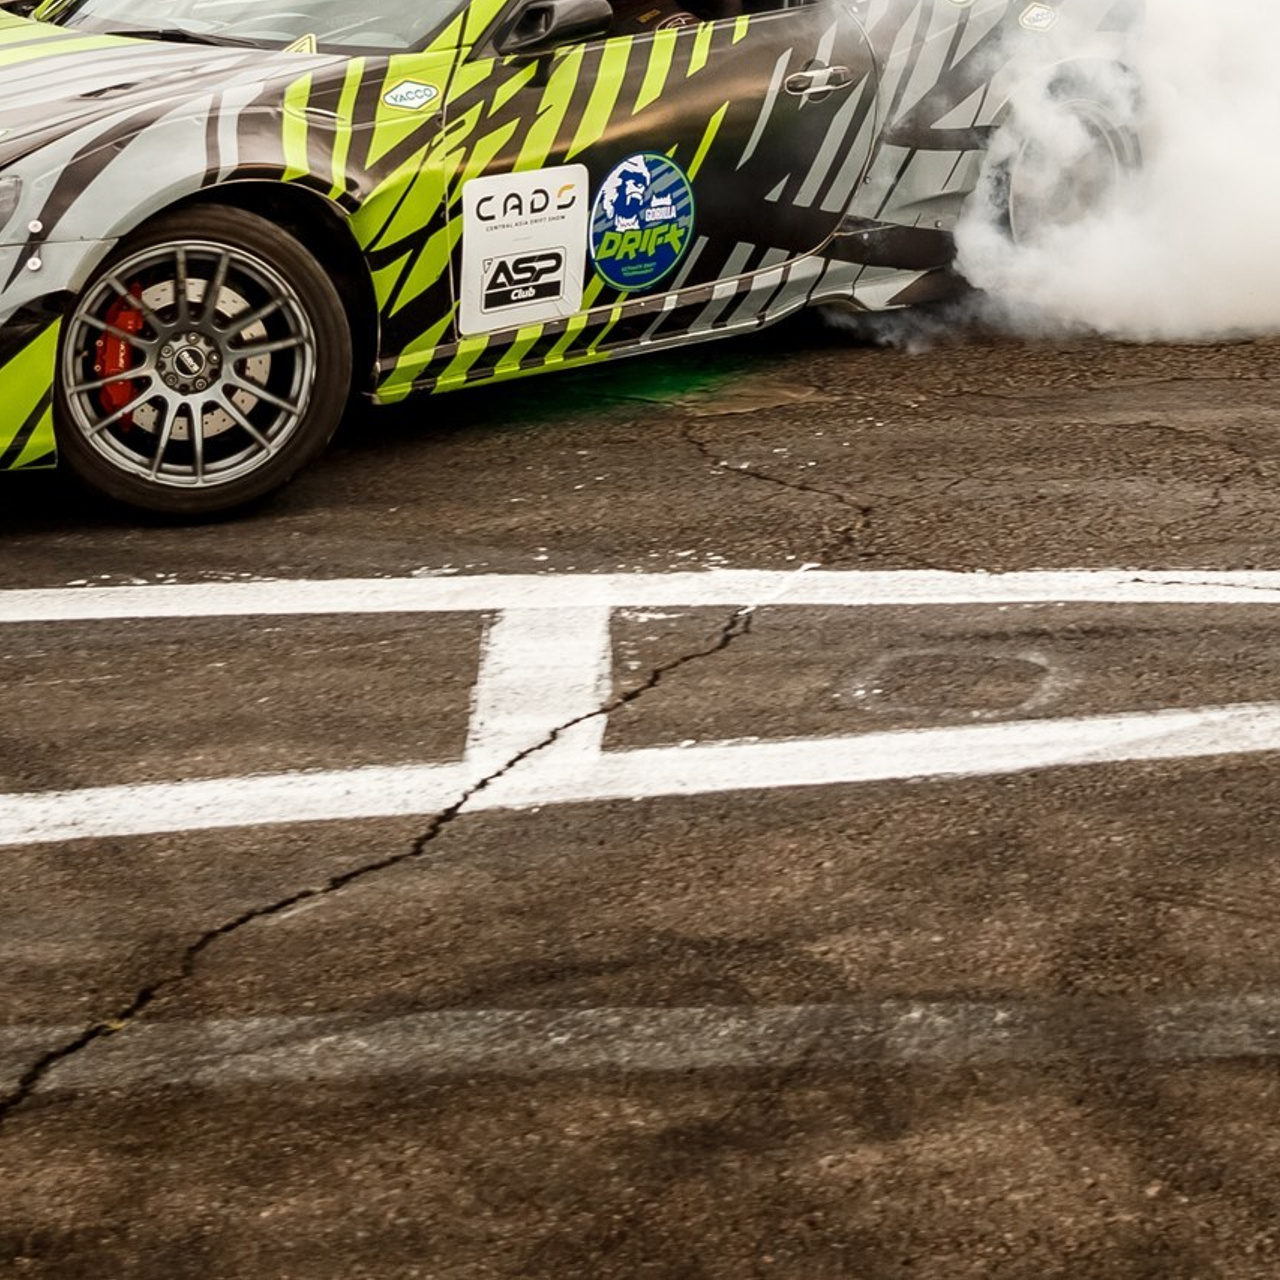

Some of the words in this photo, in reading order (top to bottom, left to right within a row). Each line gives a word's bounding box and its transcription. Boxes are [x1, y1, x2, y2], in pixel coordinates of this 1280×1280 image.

[390, 88, 433, 104] YACCO
[596, 223, 686, 260] DRIFT
[485, 252, 563, 291] ASP
[511, 287, 536, 300] Club
